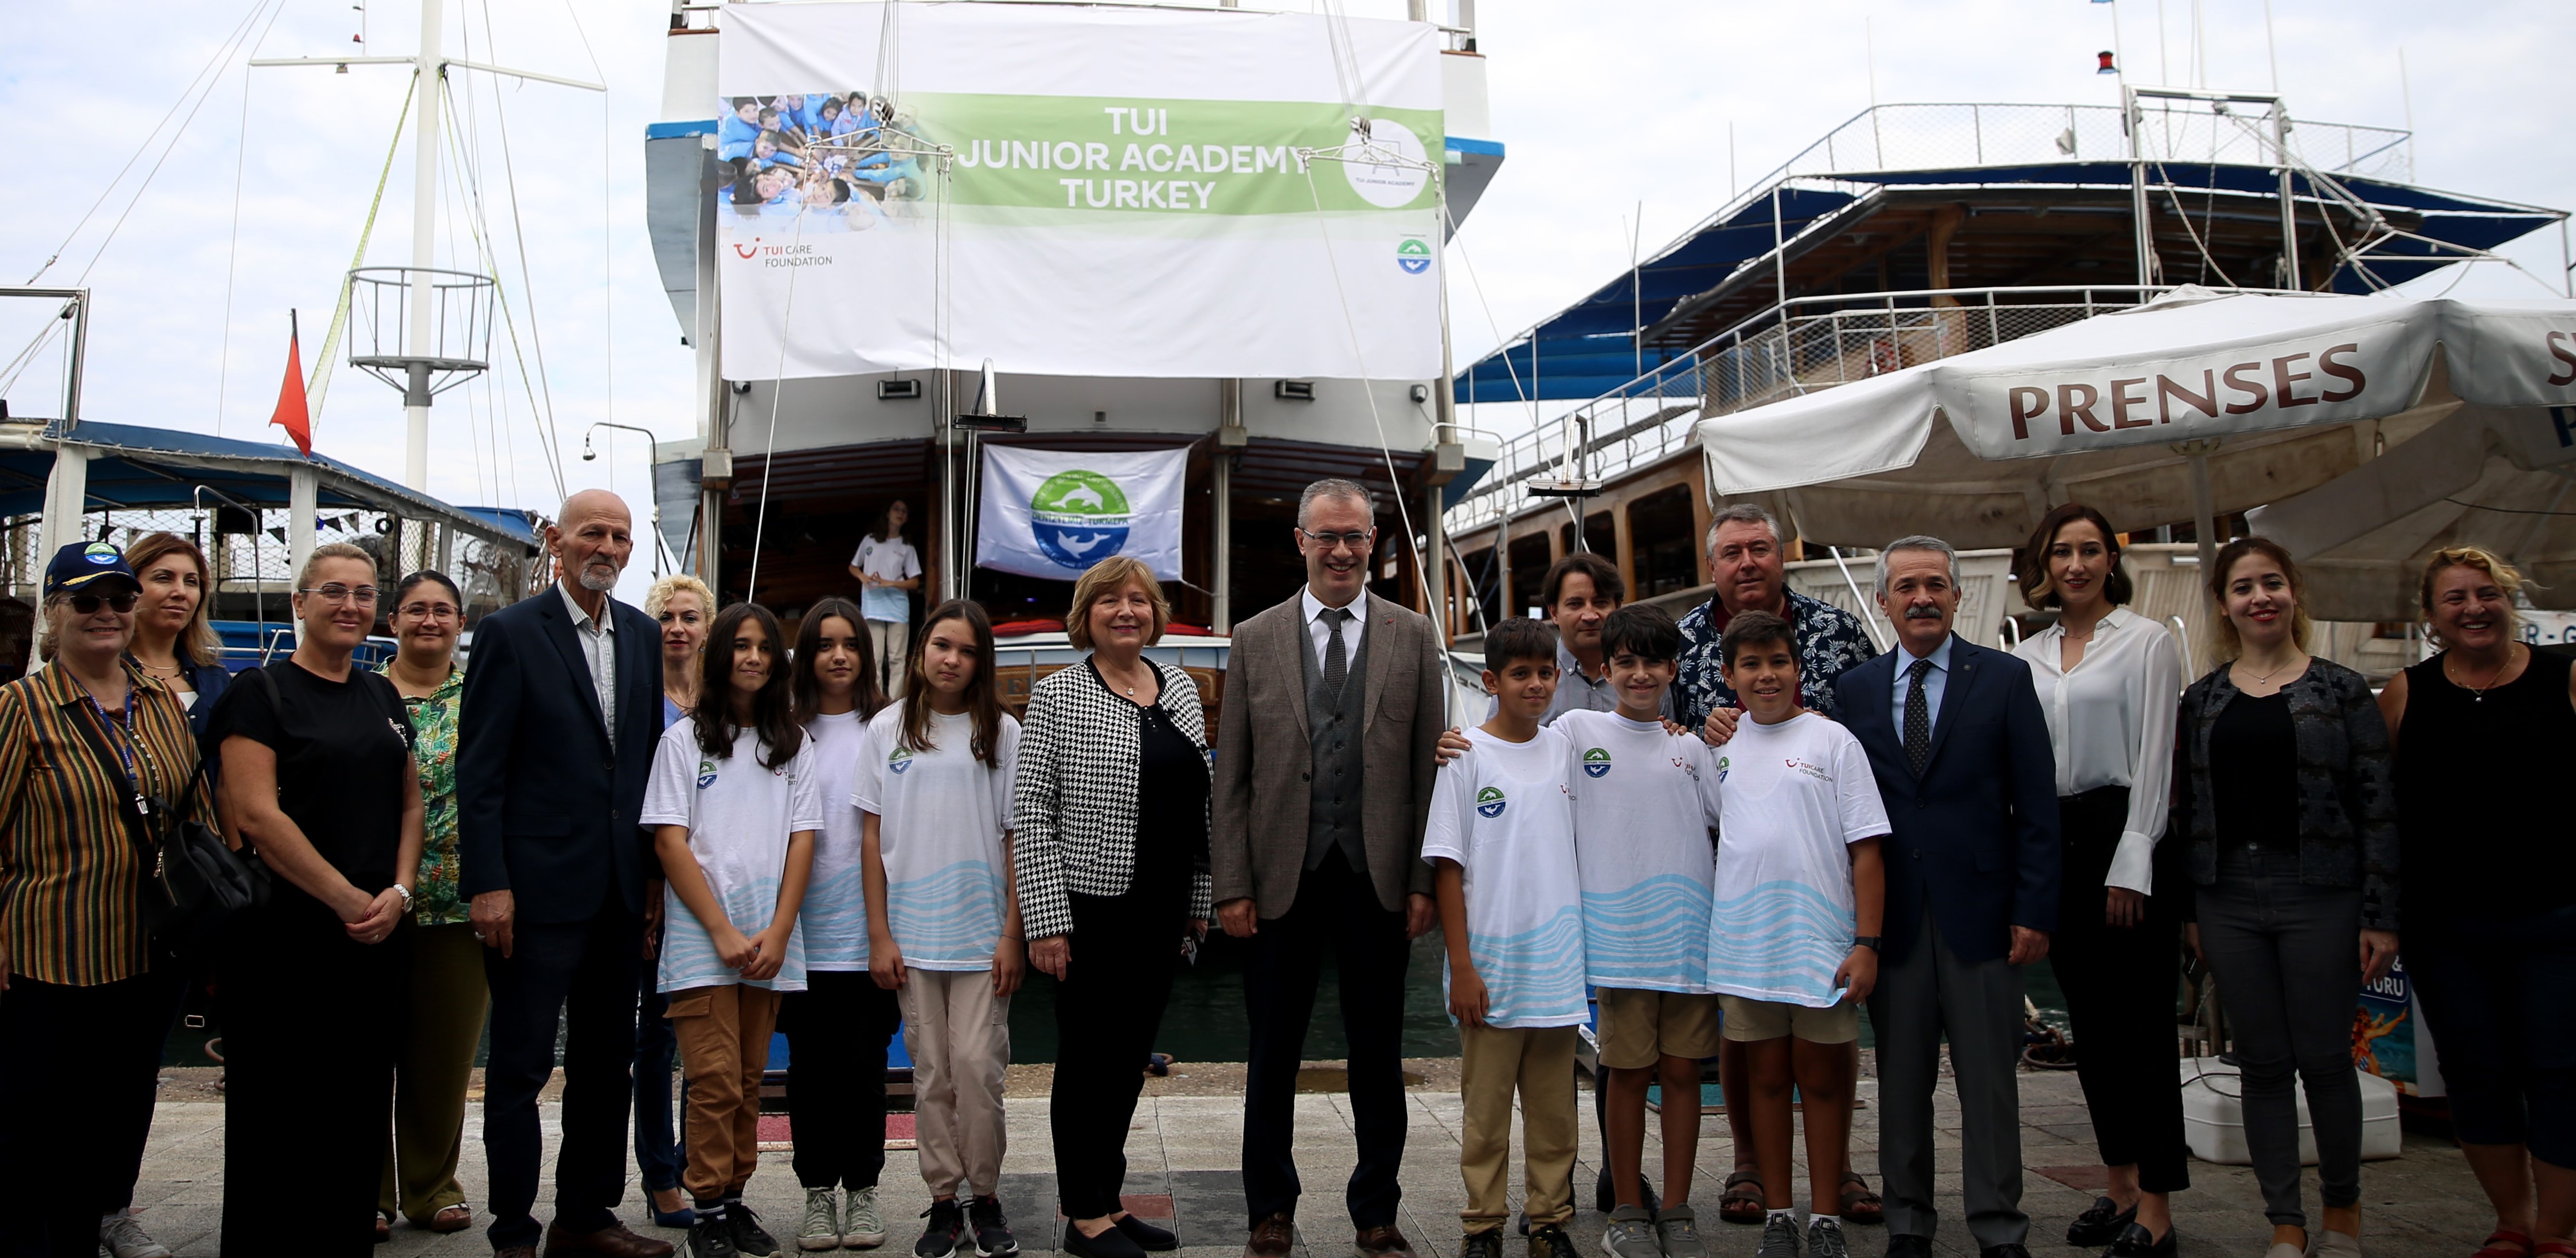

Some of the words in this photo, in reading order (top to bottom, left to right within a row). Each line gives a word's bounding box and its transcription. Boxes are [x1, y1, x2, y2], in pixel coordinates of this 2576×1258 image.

[1104, 107, 1167, 136] TUI
[957, 139, 1111, 171] JUNIOR
[1119, 143, 1313, 174] ACADEMY
[1059, 178, 1217, 210] TURKEY
[763, 246, 783, 256] TUI
[785, 245, 812, 255] CARE
[765, 256, 832, 268] FOUNDATION
[2546, 330, 2576, 386] S
[2008, 343, 2366, 440] PRENSES
[1799, 769, 1833, 782] FOUNDATION
